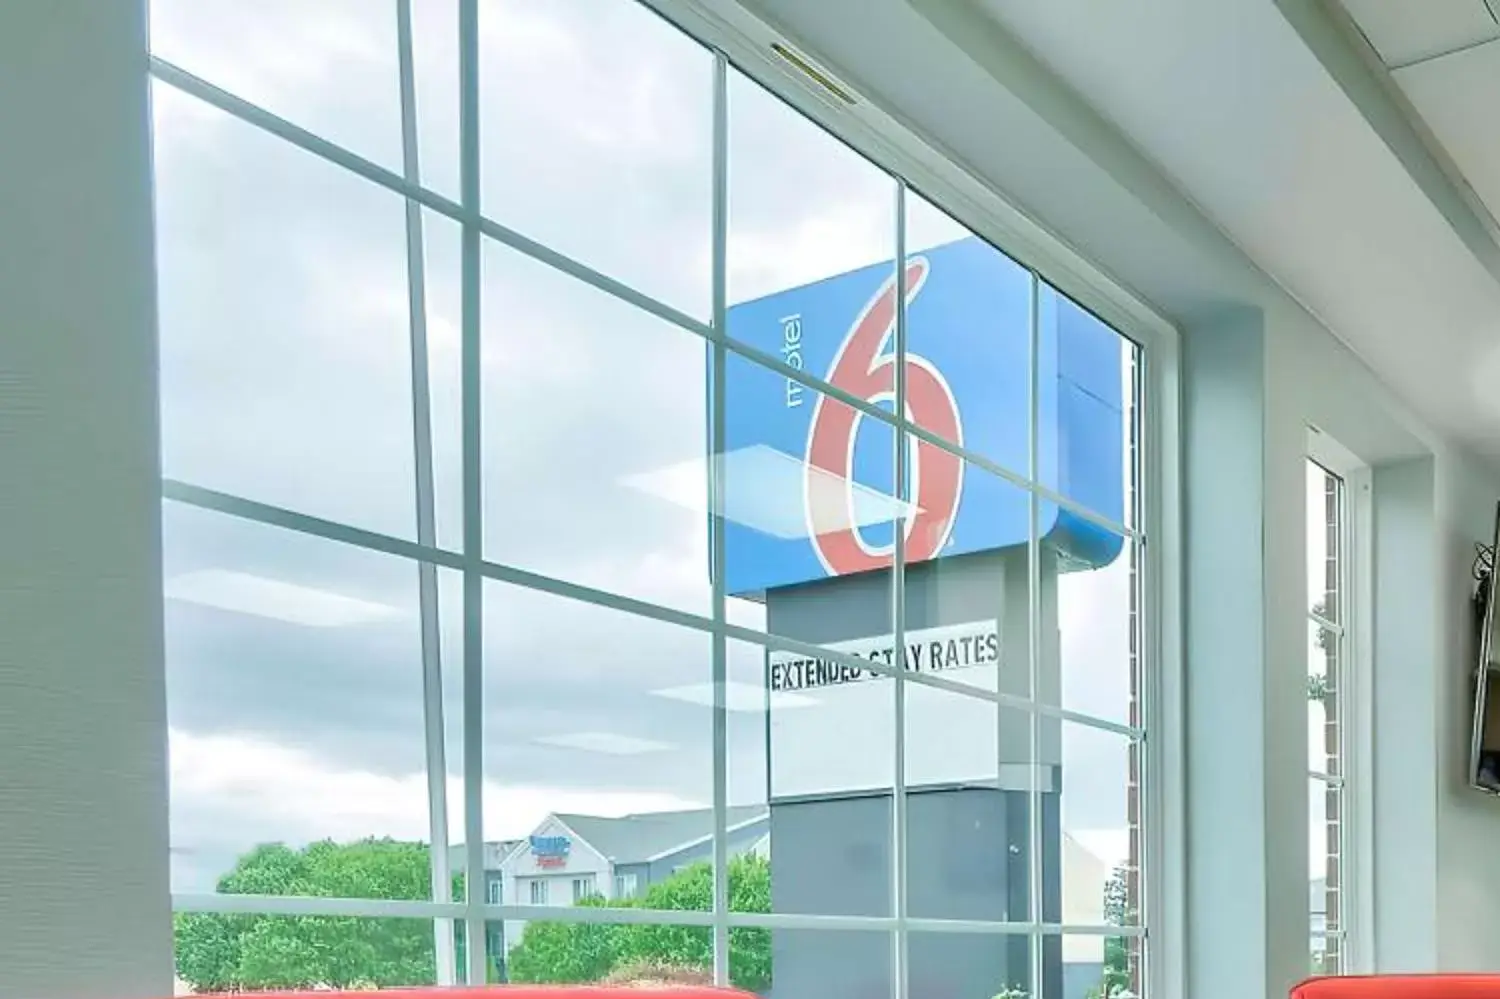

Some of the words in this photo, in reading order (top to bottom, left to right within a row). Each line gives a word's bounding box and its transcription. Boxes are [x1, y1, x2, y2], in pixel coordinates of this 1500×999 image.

[778, 313, 803, 408] motel
[804, 255, 965, 577] 6
[930, 632, 999, 672] RATES
